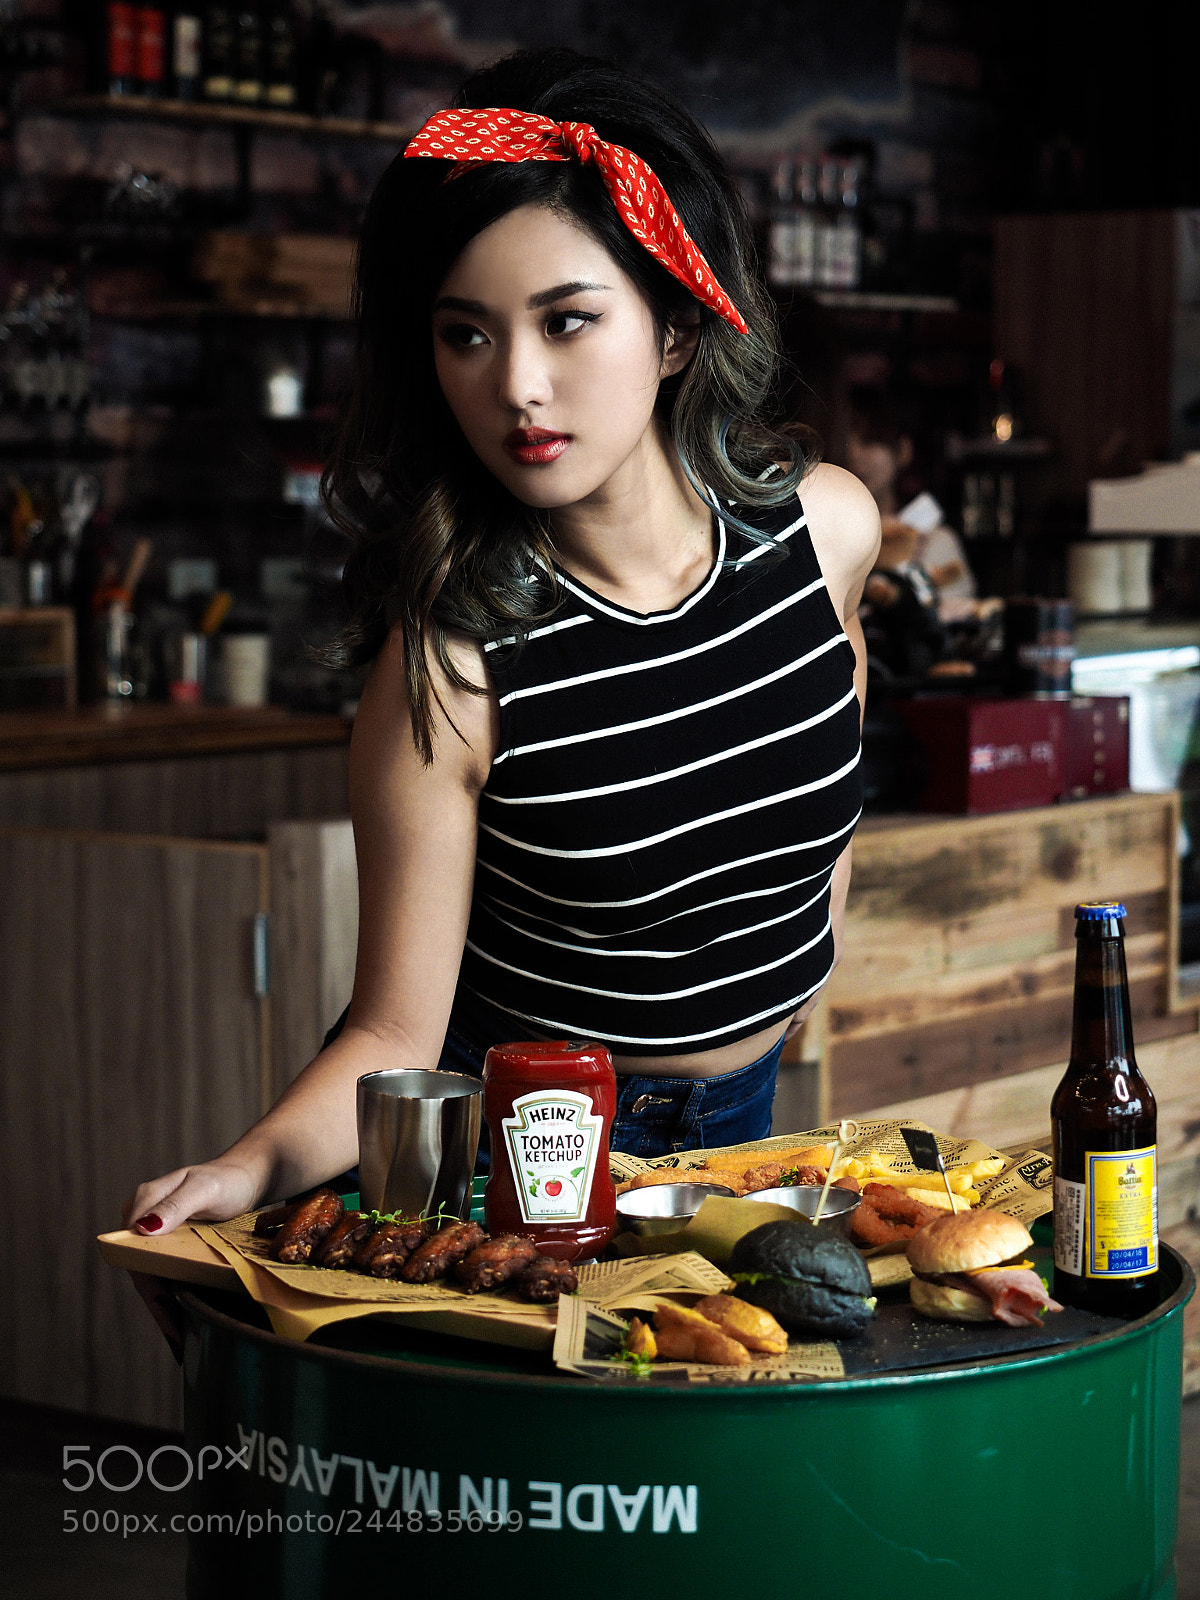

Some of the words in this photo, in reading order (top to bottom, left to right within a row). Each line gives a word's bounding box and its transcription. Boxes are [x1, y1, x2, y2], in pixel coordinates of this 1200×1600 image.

[529, 1107, 576, 1123] HEINZ
[521, 1134, 584, 1150] TOMATO
[525, 1150, 582, 1163] KETCHUP
[1111, 1259, 1143, 1270] 20/04/17
[236, 1422, 439, 1517] MALAYSIA
[459, 1474, 509, 1525] IN
[528, 1480, 698, 1533] MADE
